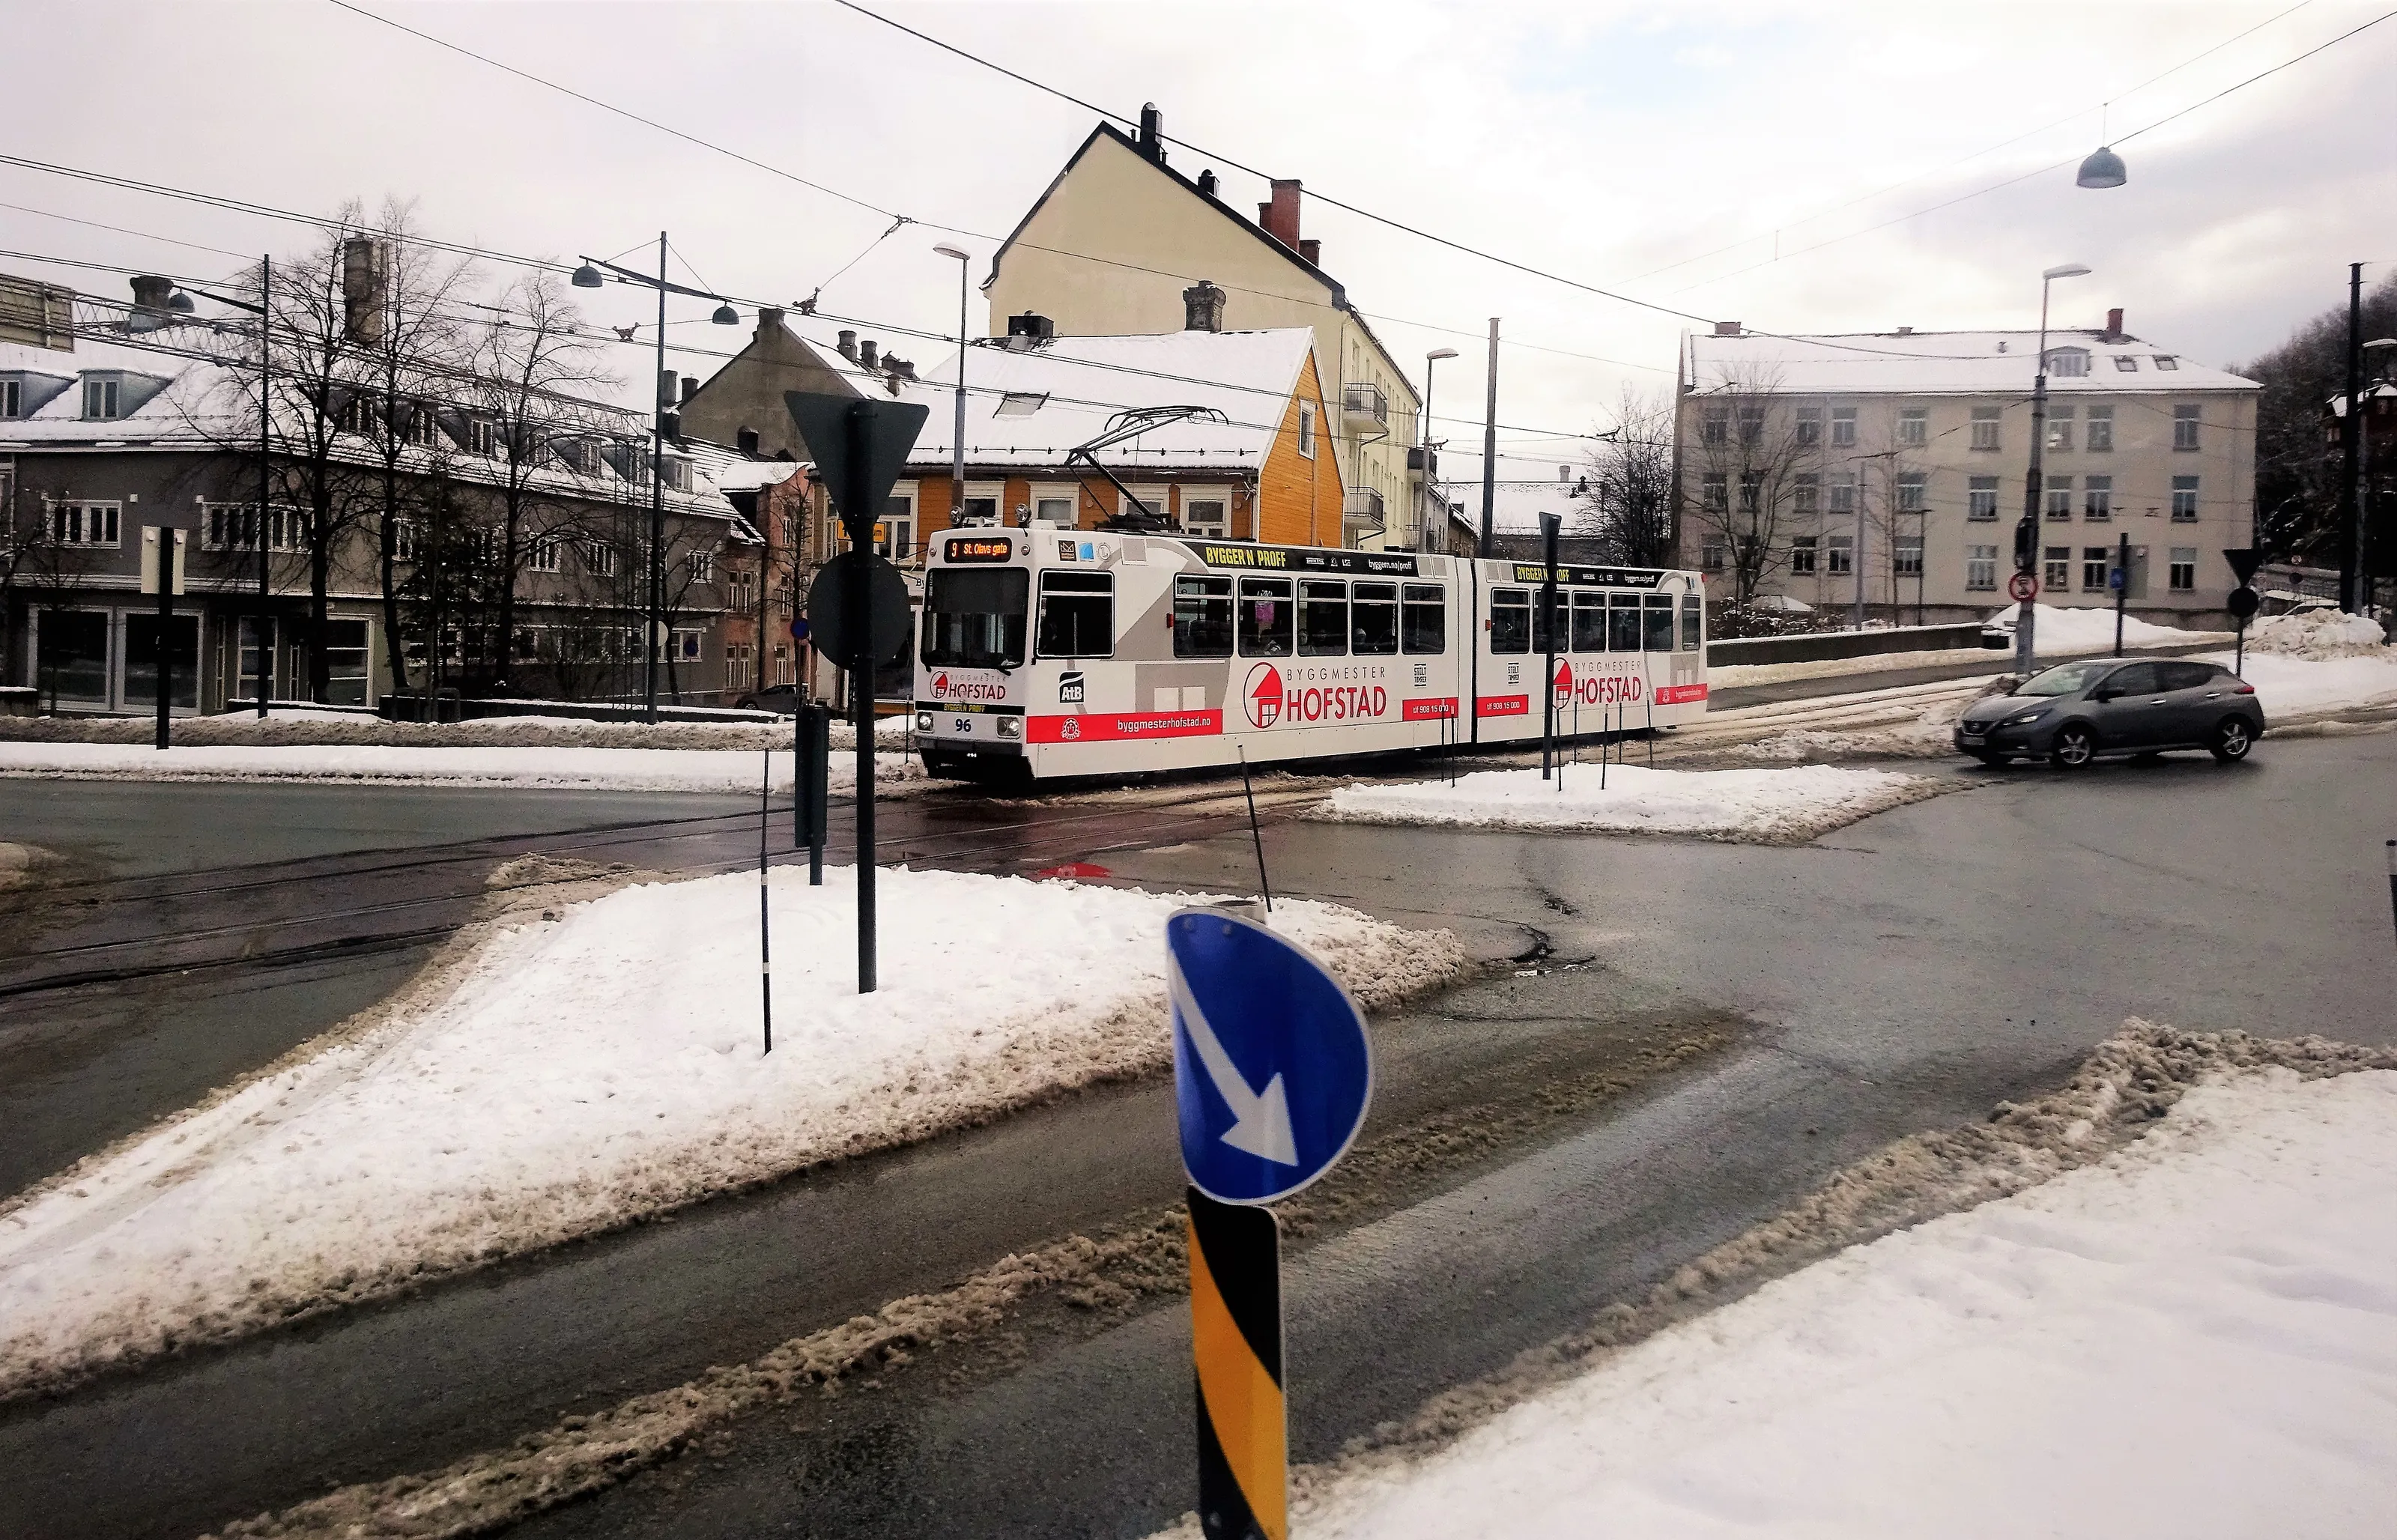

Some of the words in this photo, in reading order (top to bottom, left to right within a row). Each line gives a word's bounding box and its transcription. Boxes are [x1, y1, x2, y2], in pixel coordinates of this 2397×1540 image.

[951, 542, 957, 557] 9
[975, 543, 991, 554] Olavs
[993, 542, 1007, 556] gate
[1257, 550, 1286, 568] PROFF
[1368, 559, 1413, 572] byggern.no/proff
[1557, 569, 1569, 582] OFF
[1287, 667, 1385, 681] BYGGMESTER
[1575, 661, 1640, 672] BYGGMESTER
[950, 674, 1007, 682] BYGGMESTER
[948, 683, 1006, 700] HOFSTAD
[1061, 686, 1082, 701] AtB
[1575, 676, 1641, 704] HOFSTAD
[1287, 685, 1387, 722] HOFSTAD
[955, 718, 972, 732] 96
[1117, 716, 1210, 733] byggmesterhofstad.no
